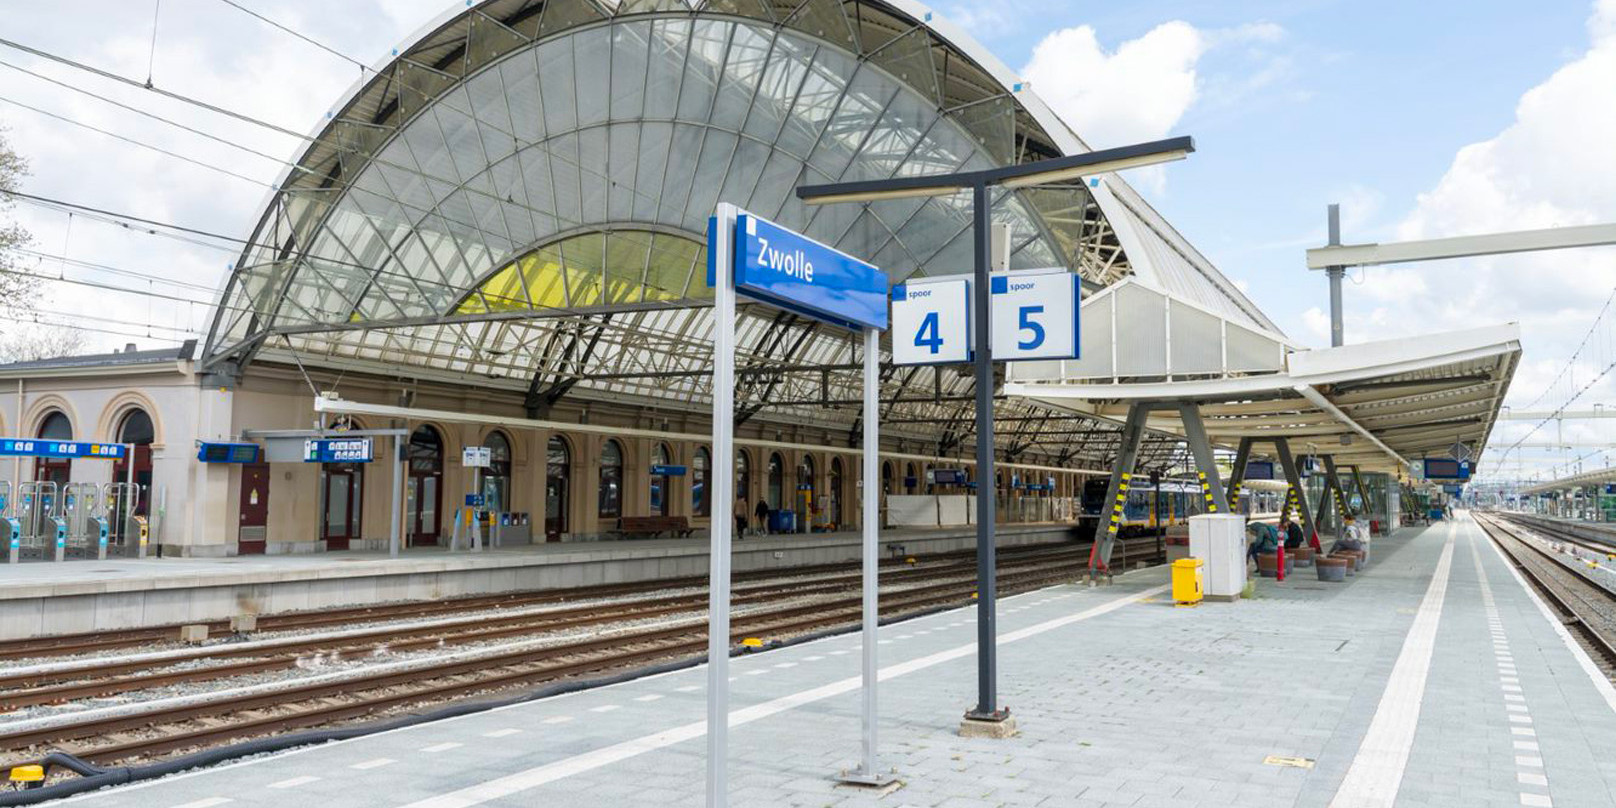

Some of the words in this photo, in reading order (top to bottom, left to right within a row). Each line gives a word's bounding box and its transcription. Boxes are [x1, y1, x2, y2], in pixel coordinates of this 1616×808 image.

[757, 237, 813, 283] Zwolle
[909, 289, 932, 299] spoor
[1010, 282, 1035, 292] spoor
[914, 312, 943, 353] 4
[1018, 305, 1046, 350] 5
